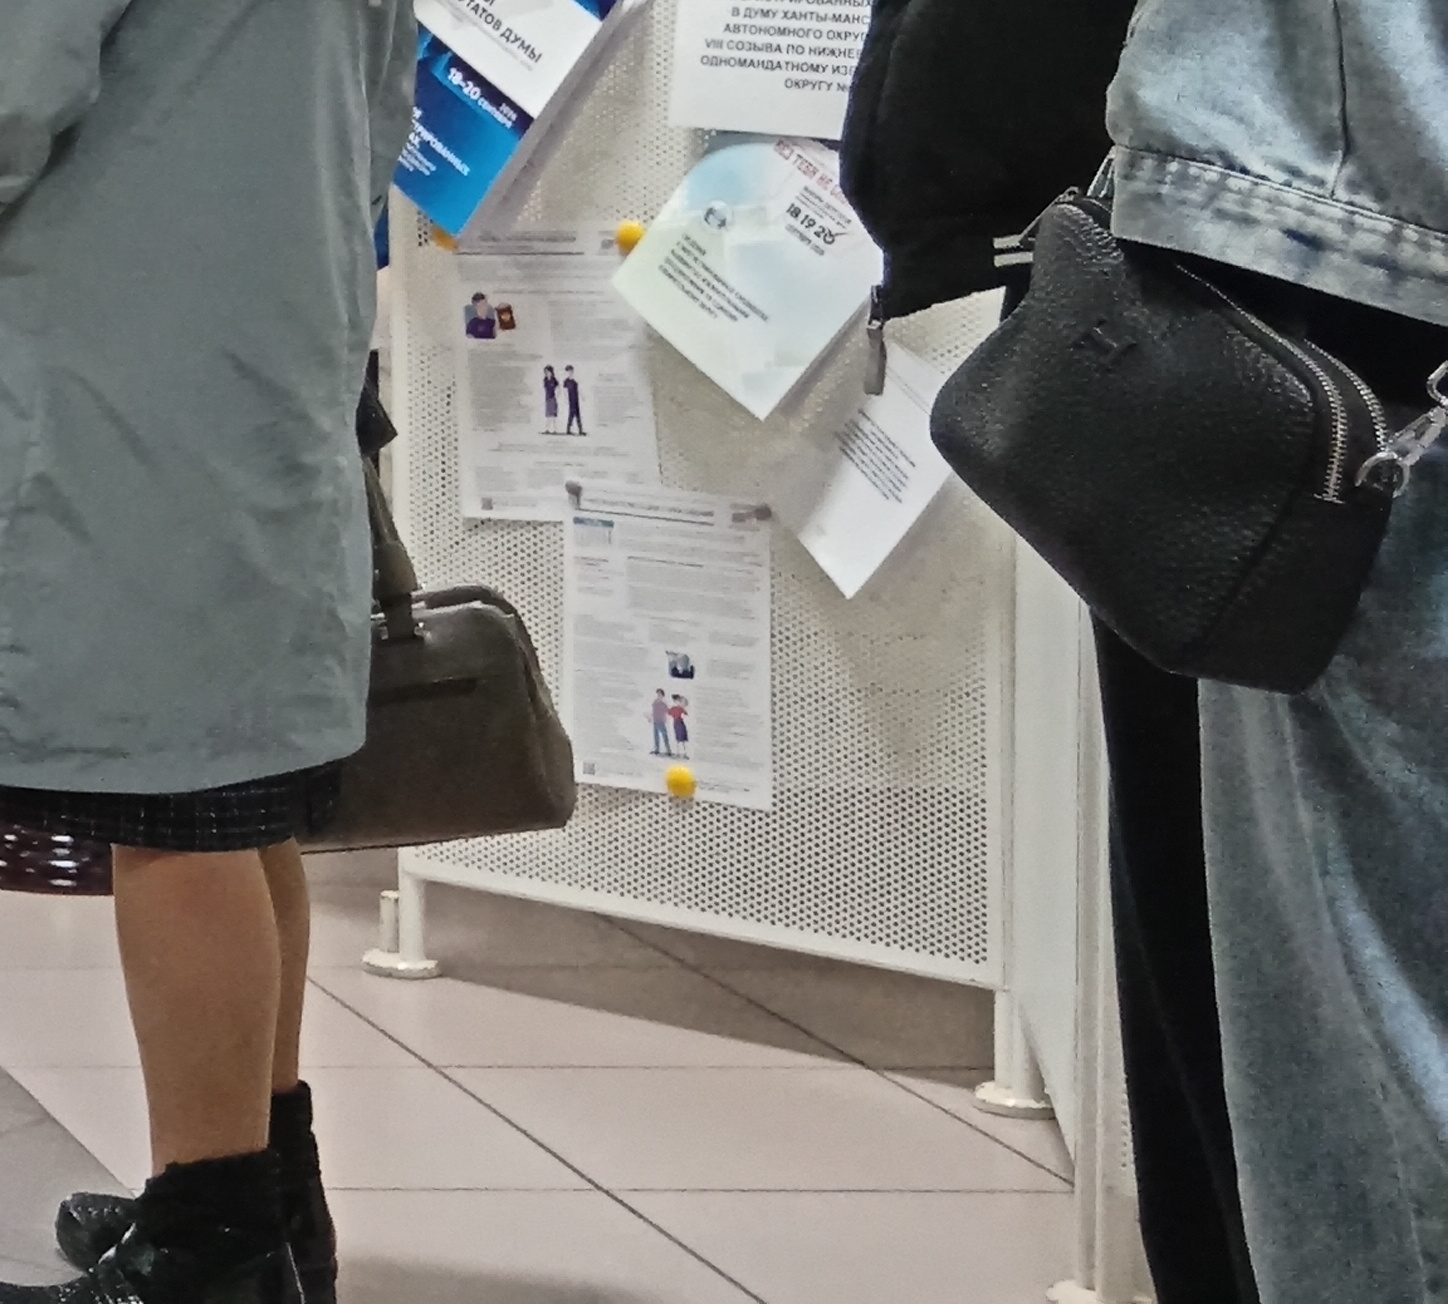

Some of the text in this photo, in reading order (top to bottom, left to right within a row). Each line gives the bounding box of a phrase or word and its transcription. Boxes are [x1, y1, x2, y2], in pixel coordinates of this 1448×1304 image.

[731, 6, 740, 18] В
[743, 7, 778, 20] ДУМУ
[723, 23, 823, 40] АВТОНОМНОГО
[500, 26, 543, 64] ДУМЫ
[726, 39, 782, 54] СОЗЫВА
[786, 44, 805, 55] ПО
[700, 54, 828, 75] ОДНОМАНДАТНОМУ
[784, 77, 833, 92] ОКРУГУ
[786, 203, 802, 221] 18
[799, 213, 817, 230] 19
[813, 223, 836, 245] 20
